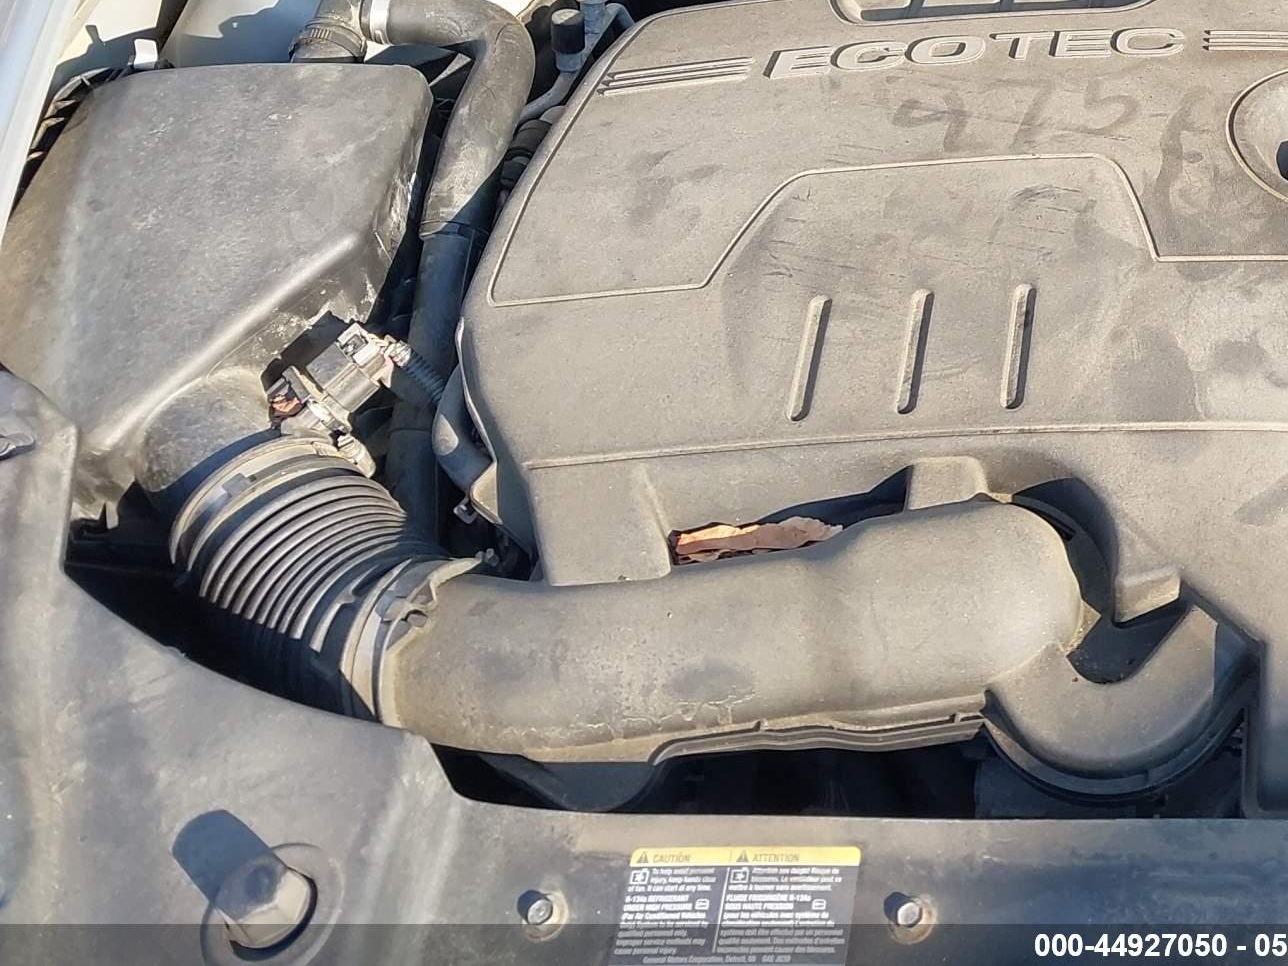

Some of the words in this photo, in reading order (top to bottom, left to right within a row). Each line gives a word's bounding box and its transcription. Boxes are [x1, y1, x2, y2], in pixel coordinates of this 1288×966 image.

[763, 26, 1185, 80] ECOTEC
[652, 853, 690, 863] CAUTION
[751, 852, 800, 863] ATTENTION
